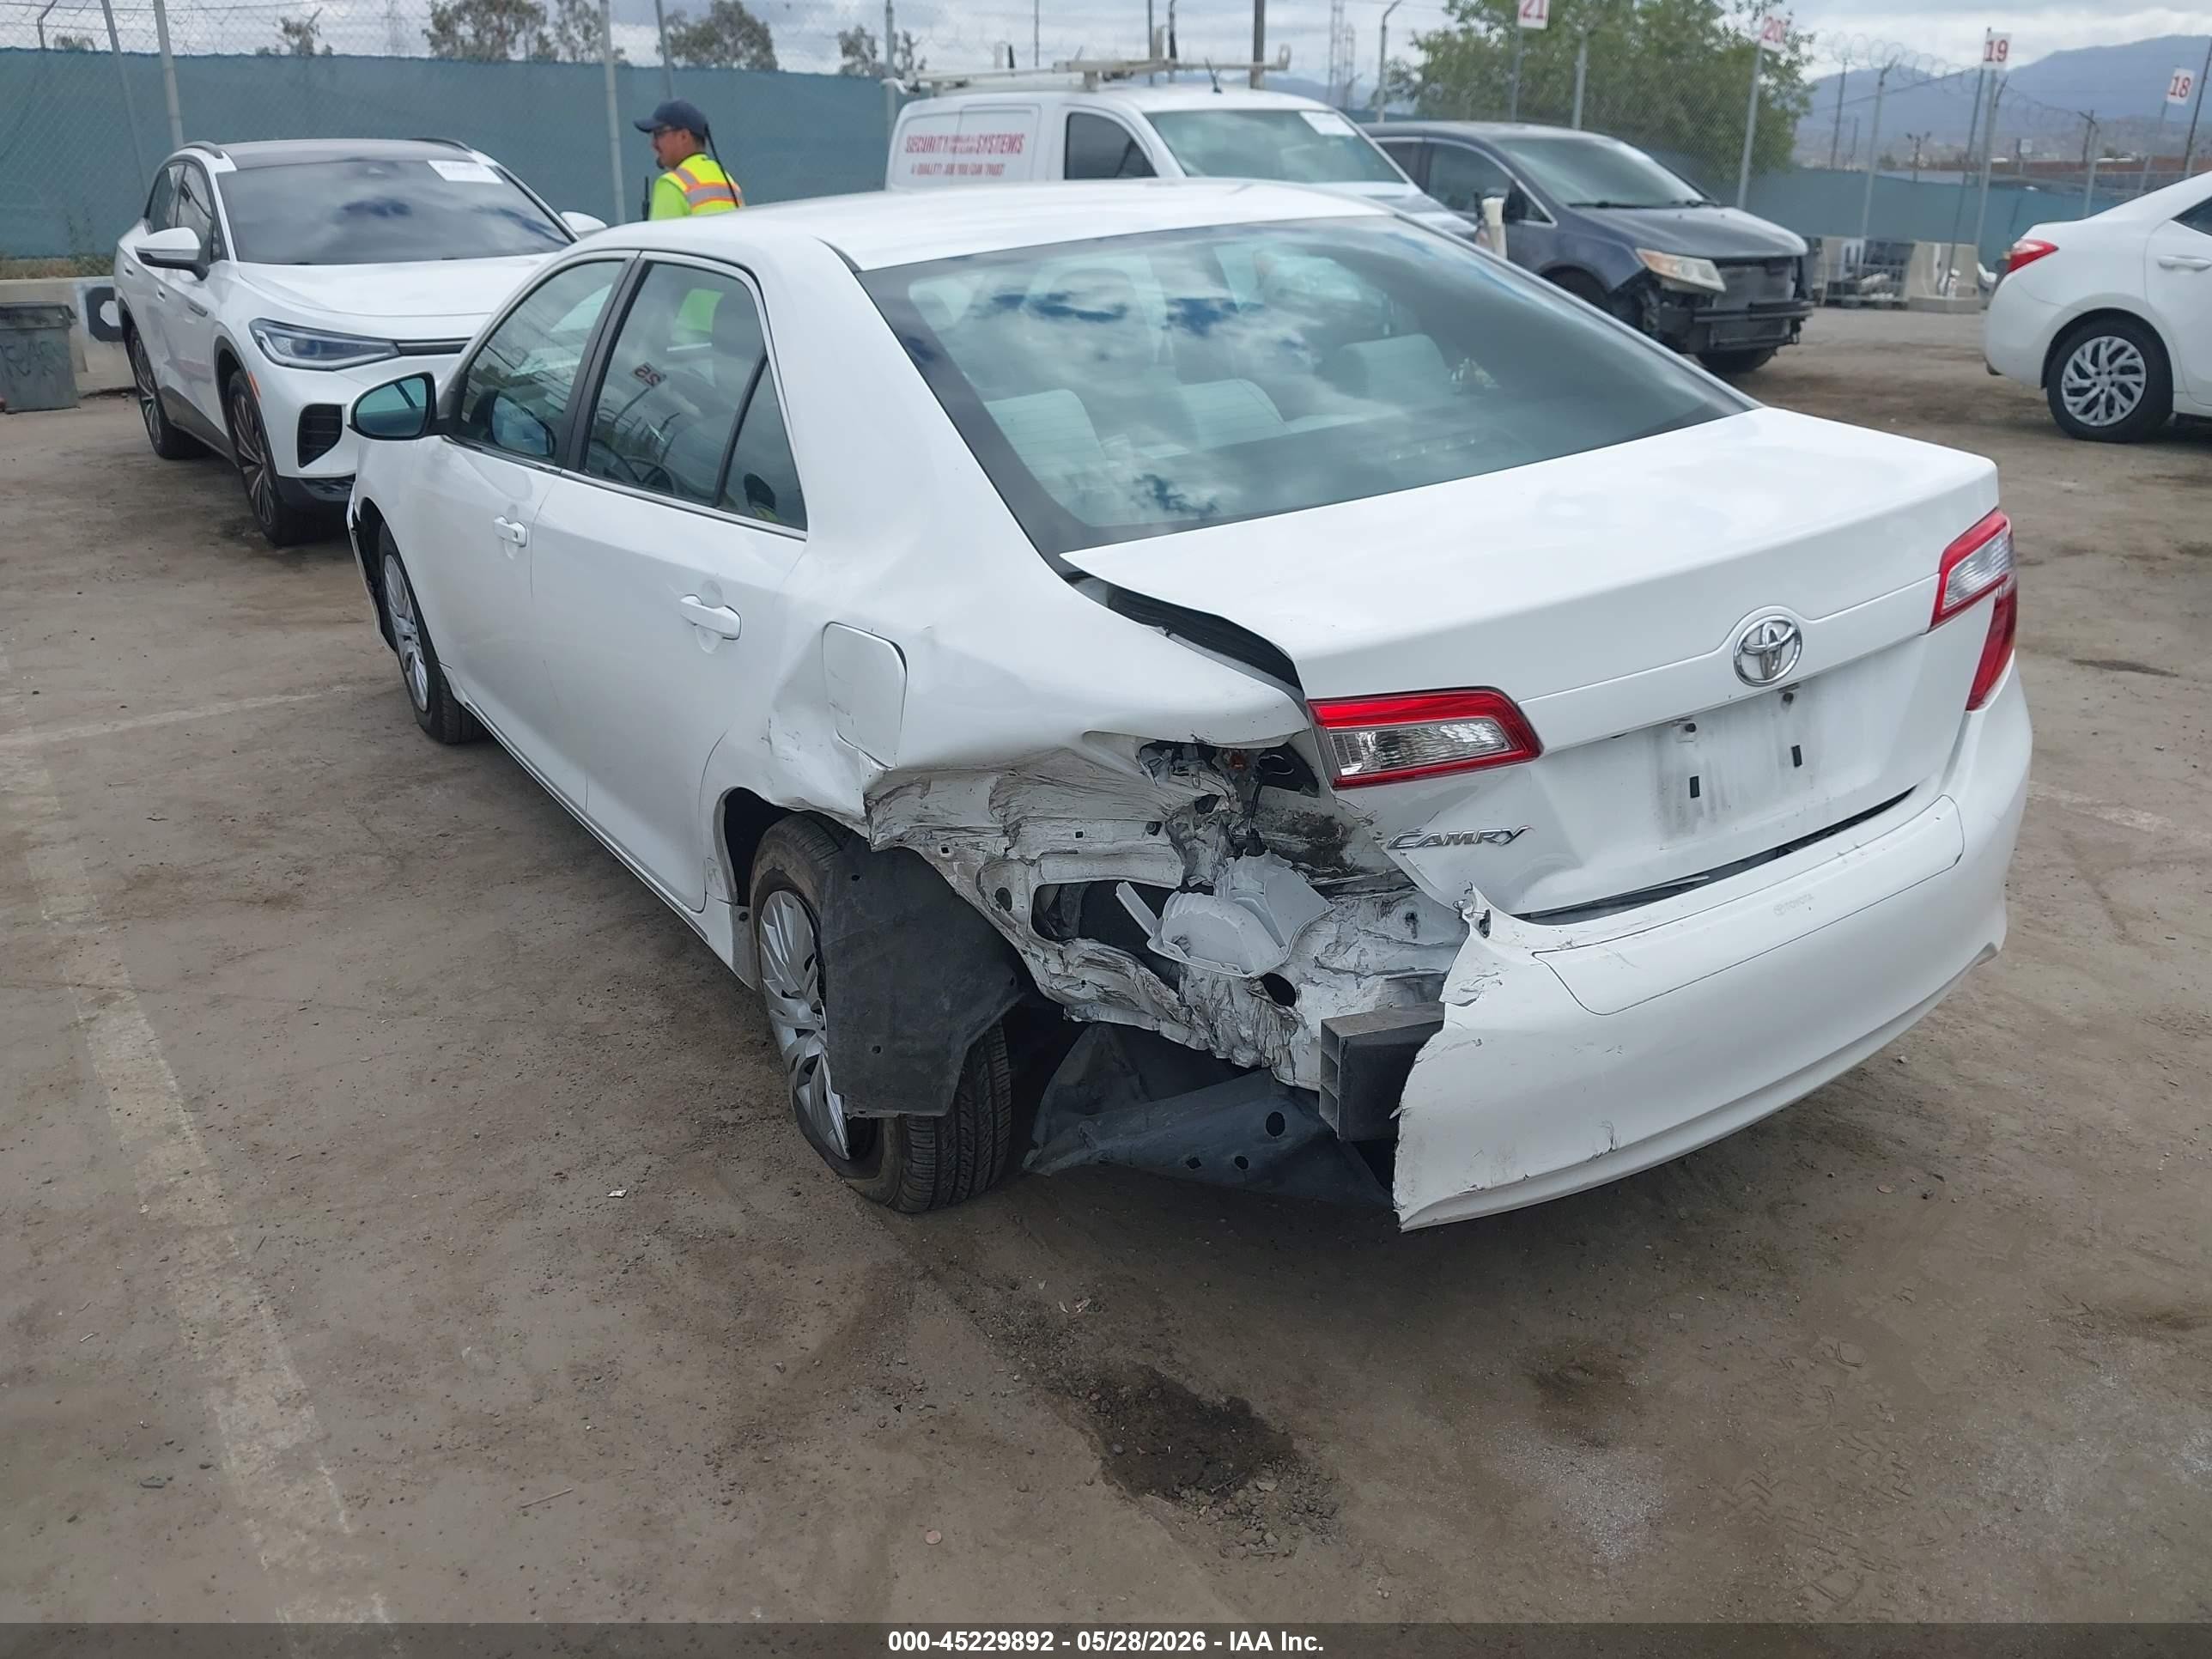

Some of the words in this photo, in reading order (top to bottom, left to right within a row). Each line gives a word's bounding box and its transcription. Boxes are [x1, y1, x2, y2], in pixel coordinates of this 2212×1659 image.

[1522, 0, 1544, 19] 21
[1763, 15, 1785, 43] 20
[1984, 40, 2008, 62] 19
[2170, 76, 2191, 98] 18
[906, 135, 948, 153] SECURITY
[976, 134, 1024, 154] SYSTEMS
[1387, 824, 1534, 850] CAMRY
